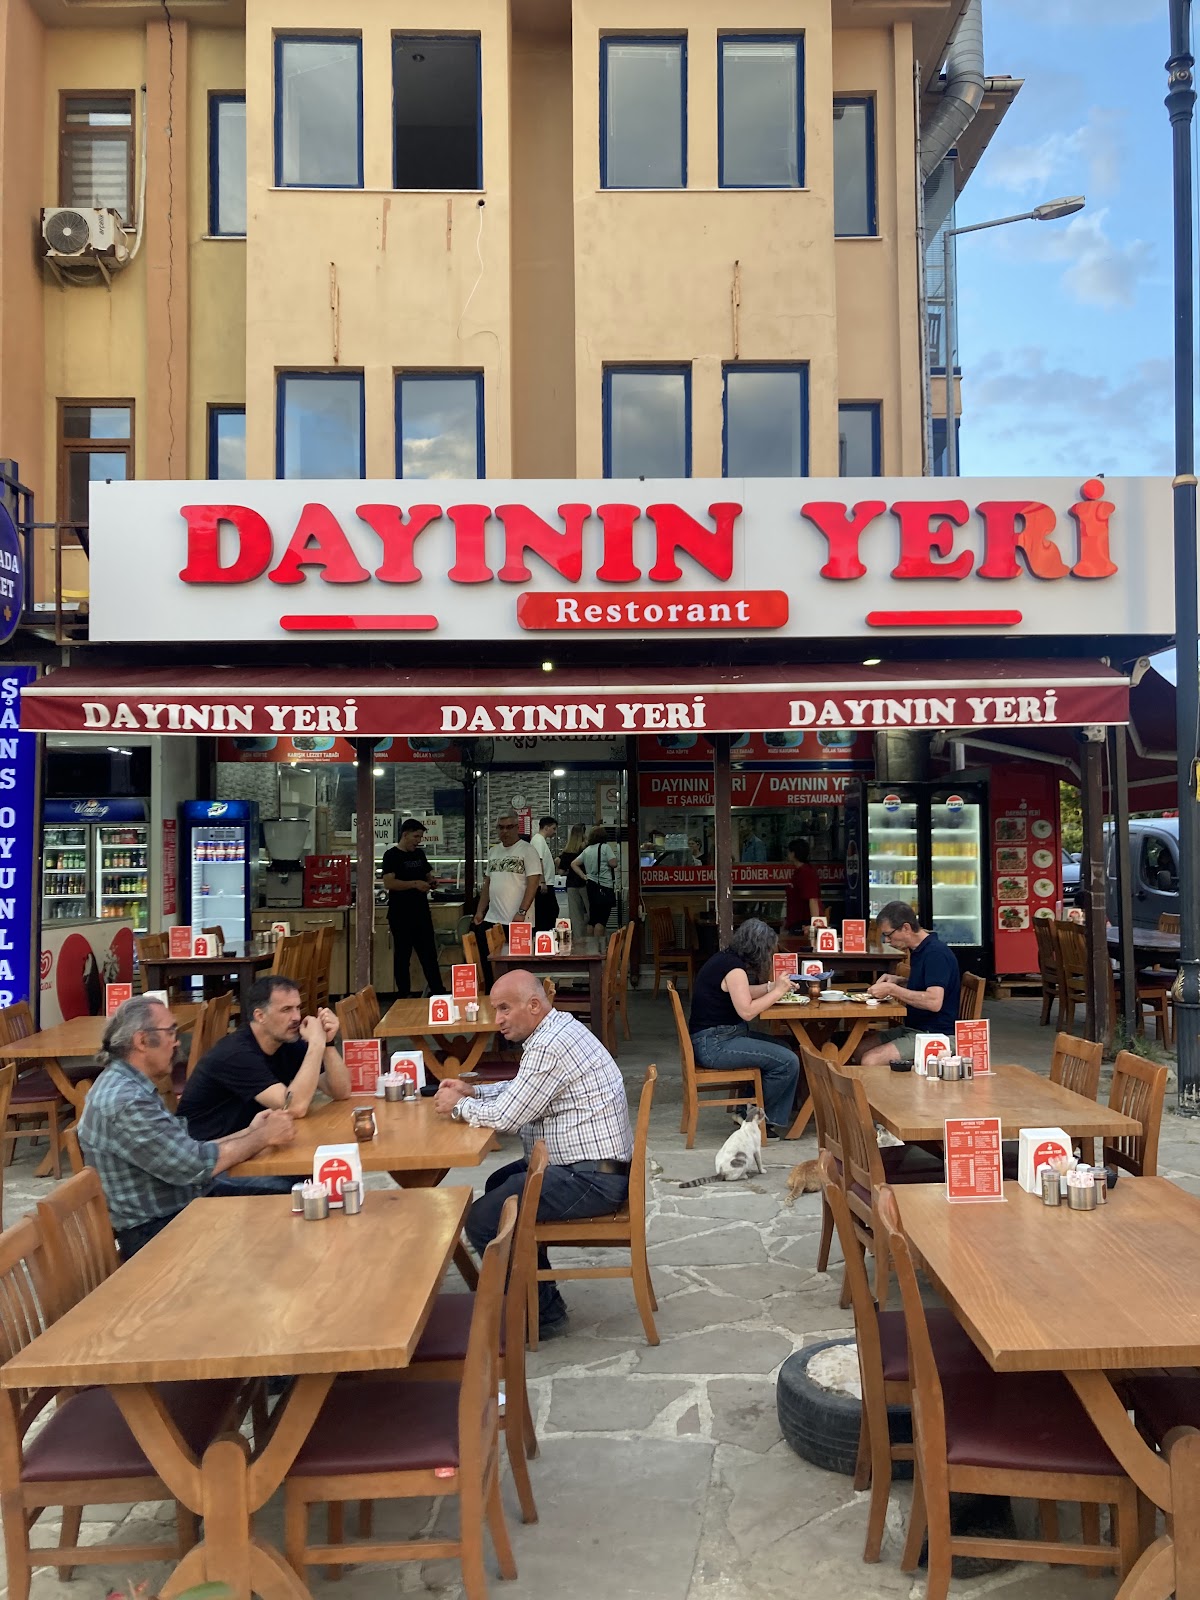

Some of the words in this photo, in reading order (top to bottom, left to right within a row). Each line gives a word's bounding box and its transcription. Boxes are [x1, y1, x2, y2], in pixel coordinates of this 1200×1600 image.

[178, 502, 742, 585] DAYININ
[800, 479, 1119, 582] YERİ
[555, 598, 751, 623] Restorant
[440, 704, 606, 731] DAYININ
[616, 695, 706, 729] YERİ
[788, 697, 956, 726] DAYININ
[966, 689, 1058, 724] YERİ
[82, 703, 255, 731] DAYININ
[264, 699, 359, 731] YERİ
[651, 778, 709, 792] DAYININ
[770, 777, 829, 791] DAYININ
[666, 795, 679, 805] ET
[198, 945, 204, 953] 2
[541, 941, 548, 951] 7
[822, 939, 833, 948] 13
[437, 1008, 444, 1019] 8
